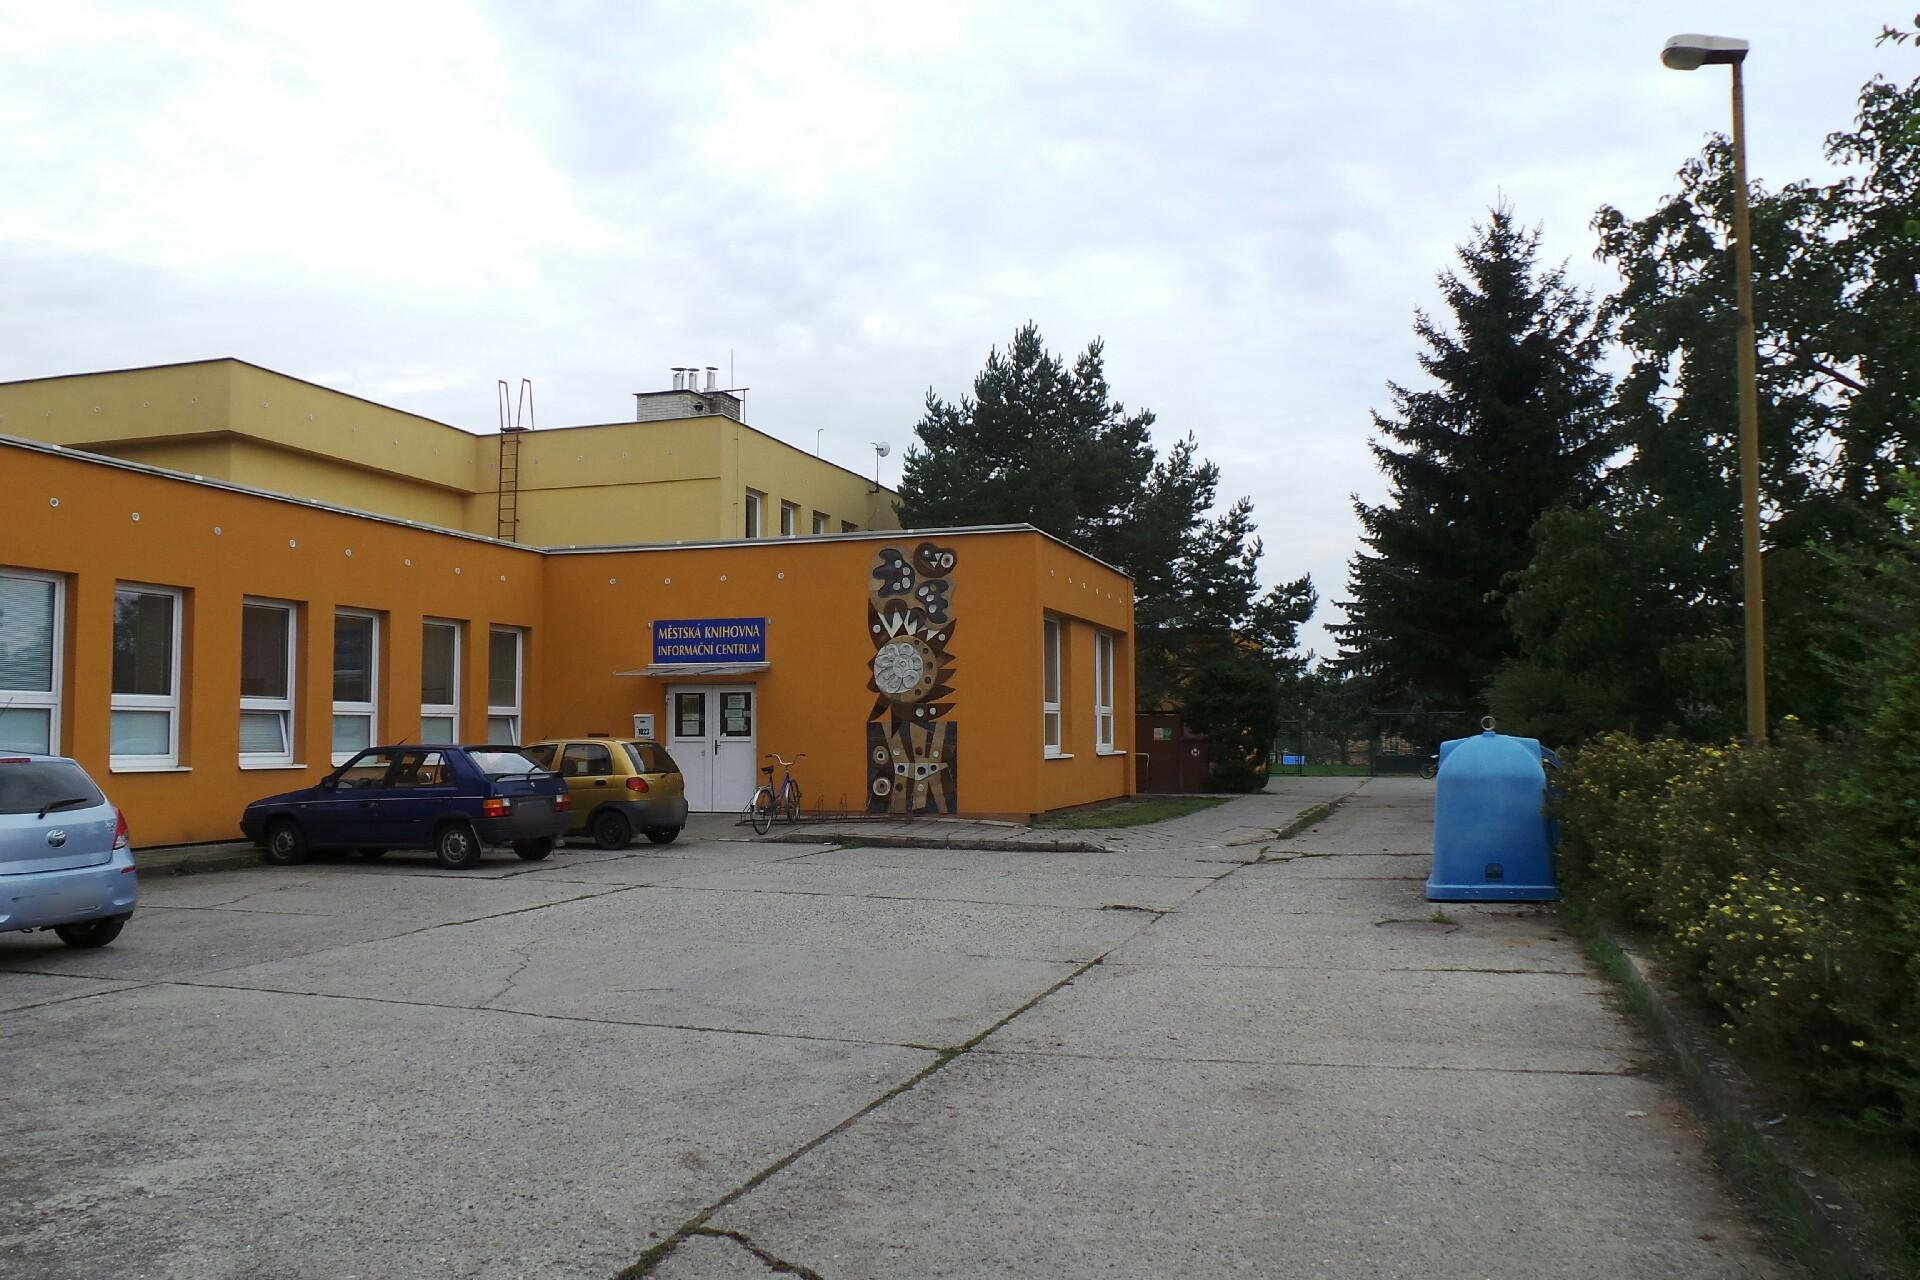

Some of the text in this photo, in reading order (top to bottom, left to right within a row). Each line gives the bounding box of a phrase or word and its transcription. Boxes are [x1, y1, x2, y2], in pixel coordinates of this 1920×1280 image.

[658, 623, 760, 640] MĚSTSKÁ KNIHOVNA
[658, 641, 760, 656] INFORMAČNÍ CENTRUM
